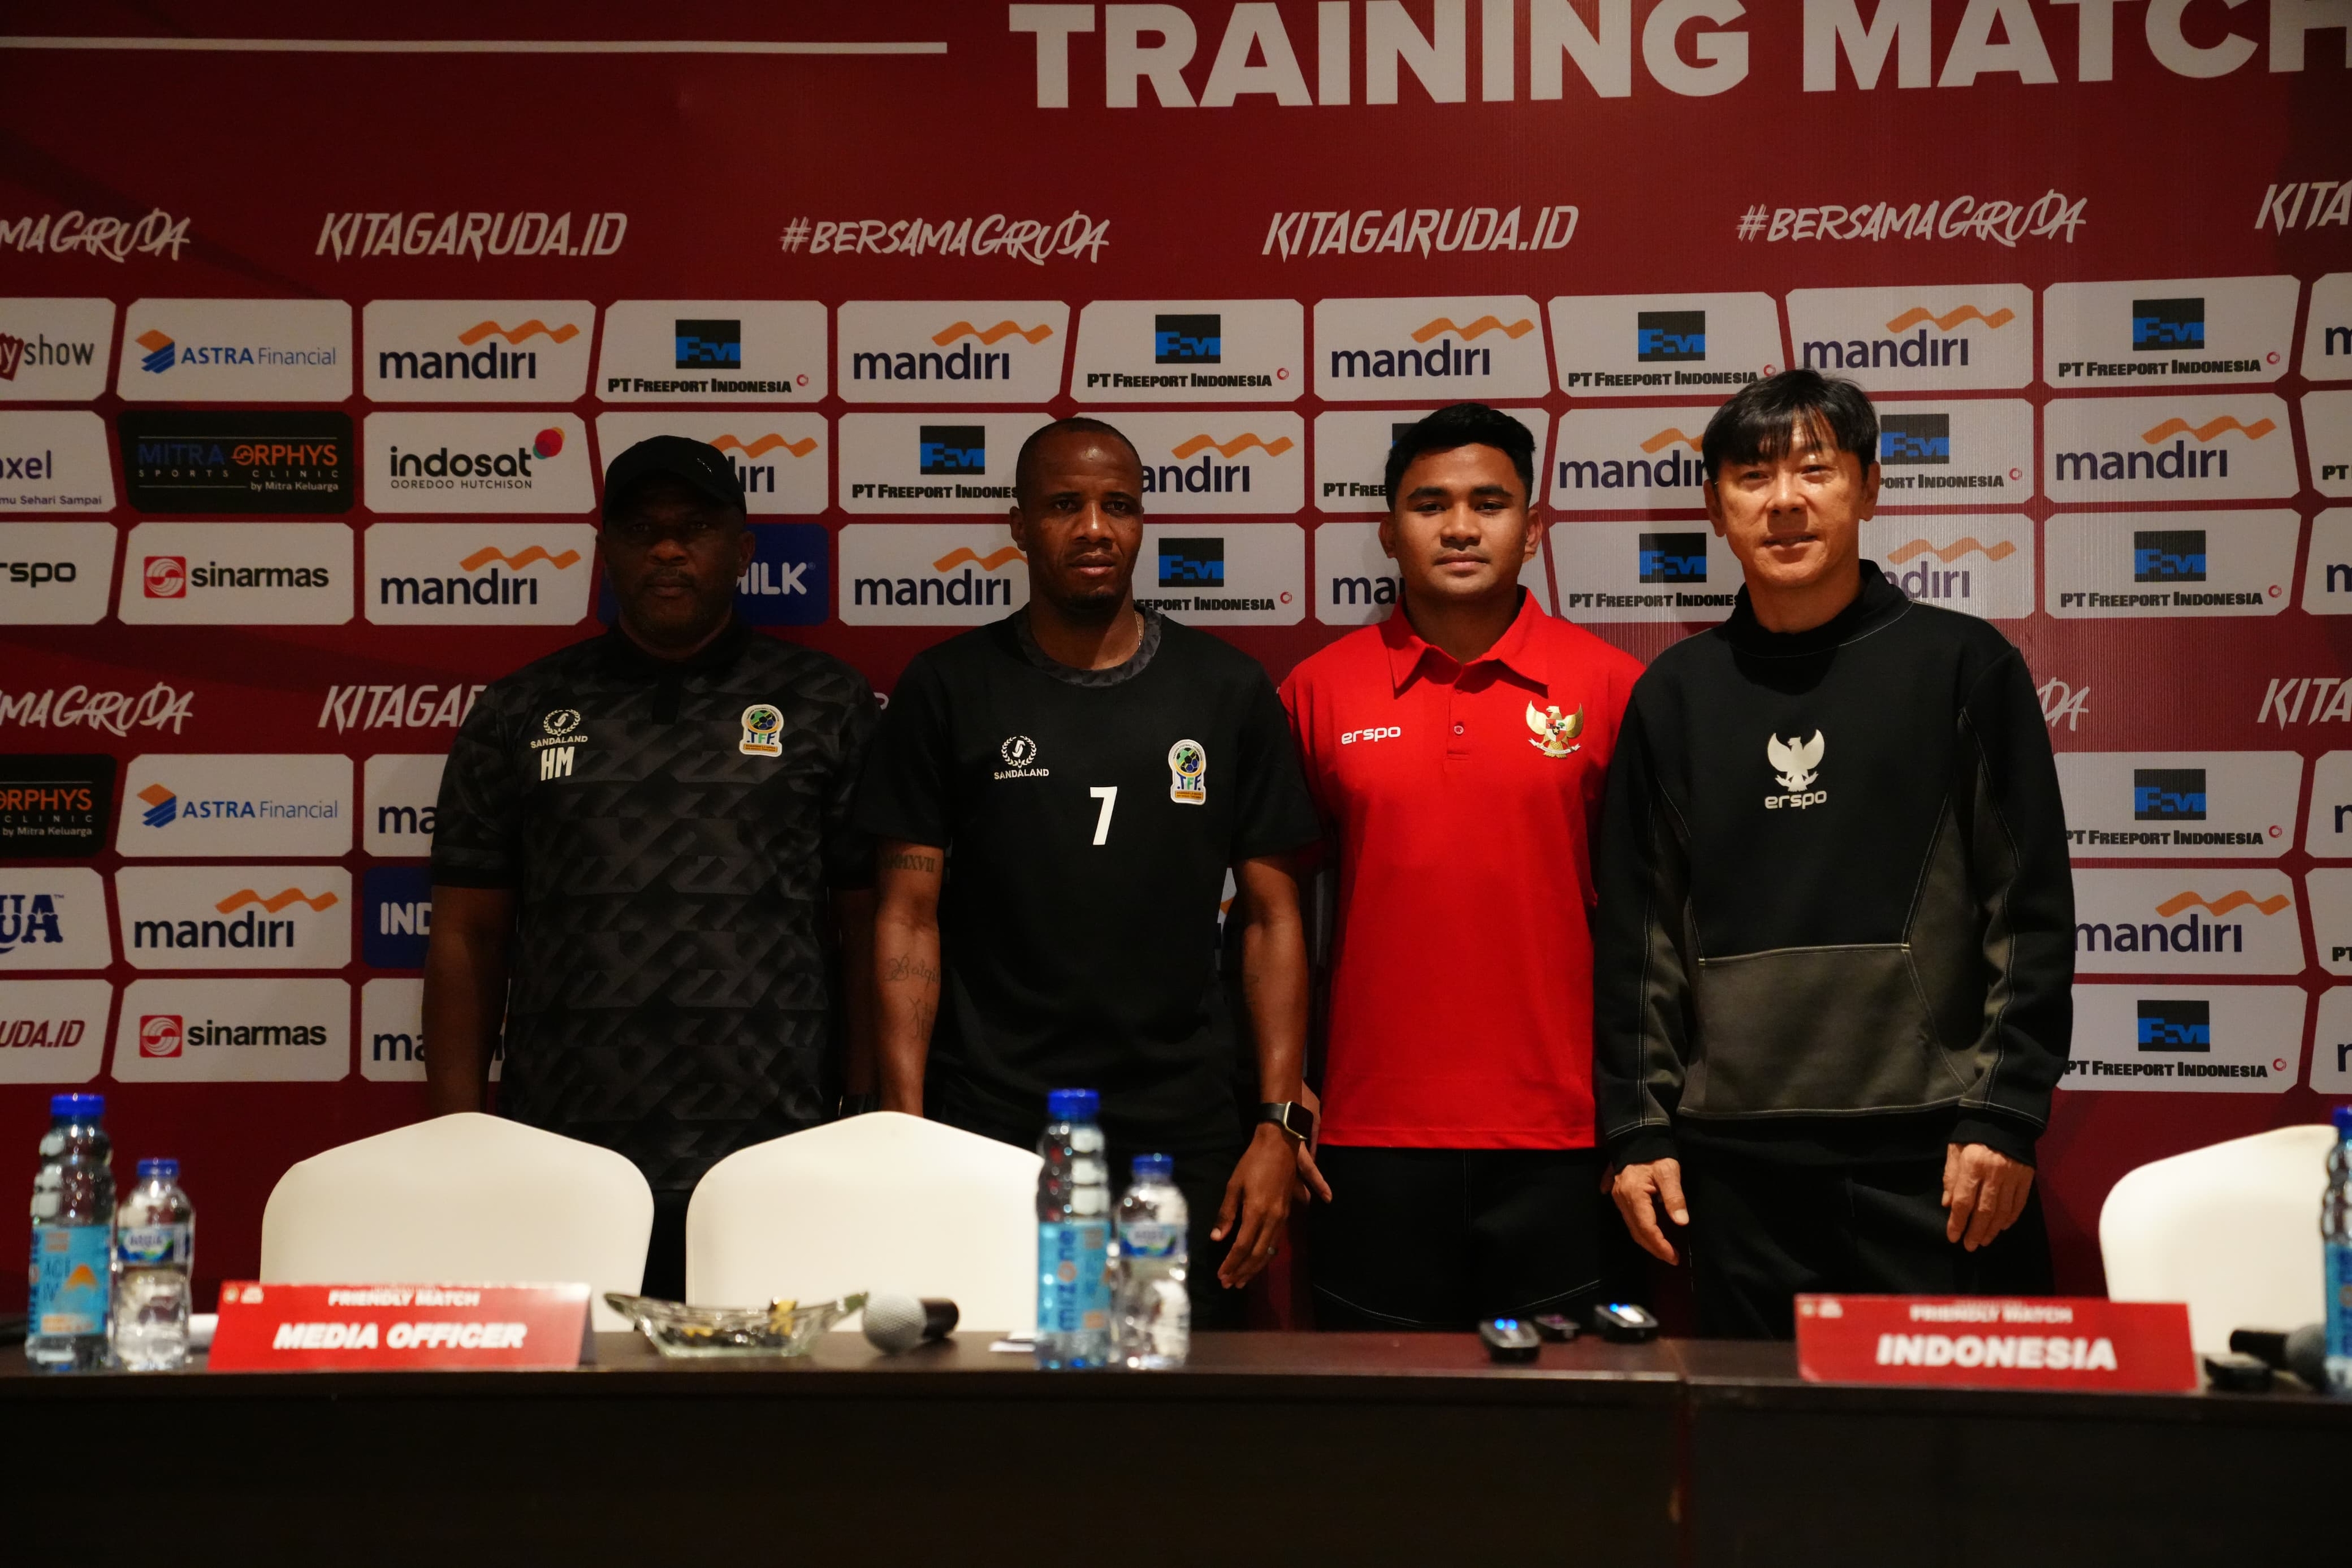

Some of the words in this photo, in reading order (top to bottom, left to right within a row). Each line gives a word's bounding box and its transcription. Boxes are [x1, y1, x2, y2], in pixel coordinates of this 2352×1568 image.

[1009, 0, 1749, 108] TRAINING
[1803, 0, 2352, 91] MATCH
[1736, 189, 2087, 247] #BERSAMAGARUDA
[2255, 178, 2352, 236] KITA
[0, 208, 190, 263] MAGARUDA
[315, 212, 628, 262] KITAGARUDA.ID
[778, 211, 1109, 266] #BERSAMAGARUDA
[1262, 205, 1579, 262] KITAGARUDA.ID
[0, 334, 94, 374] yshow
[181, 347, 254, 364] ASTRA
[258, 347, 336, 366] Financial
[380, 342, 535, 379] mandiri
[854, 343, 1009, 379] mandiri
[1332, 339, 1490, 378] mandiri
[1803, 330, 1968, 369] mandiri
[1088, 373, 1109, 387] PT
[1113, 373, 1188, 386] FREEPORT
[1191, 373, 1272, 387] INDONESIA
[1569, 372, 1593, 386] PT
[1595, 372, 1672, 386] FREEPORT
[1675, 371, 1758, 385] INDONESIA
[2059, 362, 2084, 377] PT
[2086, 361, 2168, 375] FREEPORT
[2171, 360, 2261, 374] INDONESIA
[608, 378, 630, 392] PT
[633, 379, 707, 393] FREEPORT
[710, 379, 791, 393] INDONESIA
[137, 443, 225, 466] MITRA
[231, 444, 338, 466] ORPHYS
[390, 446, 532, 477] indosat
[2056, 440, 2228, 480] mandiri
[391, 480, 454, 489] OOREDOO
[461, 480, 532, 489] HUTCHISON
[1142, 456, 1250, 492] andiri
[1918, 473, 2004, 489] INDONESIA
[2323, 465, 2349, 480] PT
[251, 481, 262, 492] by
[265, 481, 292, 491] Mitra
[295, 481, 339, 493] Keluarga
[853, 484, 875, 498] PT
[878, 484, 953, 499] FREEPORT
[956, 484, 1019, 498] INDONES
[1324, 483, 1347, 497] PT
[1350, 483, 1387, 497] FREE
[20, 496, 56, 505] Sehari
[59, 496, 102, 506] Sampai
[191, 562, 328, 587] sinarmas
[381, 568, 537, 605] mandiri
[854, 569, 1011, 605] mandiri
[1194, 597, 1275, 611] INDONESIA
[1570, 594, 1594, 608] PT
[1596, 593, 1673, 607] FREEPORT
[2061, 593, 2086, 608] PT
[2089, 592, 2171, 607] FREEPORT
[2174, 591, 2263, 606] INDONESIA
[0, 682, 194, 737] MAGARUDA
[317, 684, 488, 736] KITAGA
[2256, 677, 2352, 731] KITA
[530, 735, 588, 748] SANDALAND
[1341, 726, 1401, 745] erspo
[540, 746, 575, 781] HM
[993, 768, 1049, 780] SANDALAND
[183, 802, 255, 818] ASTRA
[260, 801, 338, 819] Financial
[1765, 790, 1826, 809] erspo
[1090, 786, 1117, 845] 7
[2, 827, 14, 837] by
[17, 827, 45, 835] Mitra
[48, 827, 92, 837] Keluarga
[2089, 831, 2170, 845] FREEPORT
[2174, 831, 2263, 845] INDONESIA
[134, 911, 293, 948] mandiri
[2075, 914, 2242, 952] mandiri
[187, 1019, 326, 1046] sinarmas
[2065, 1061, 2089, 1076] PT
[2092, 1062, 2174, 1077] FREEPORT
[2177, 1063, 2267, 1078] INDONESIA
[273, 1322, 379, 1349] MEDIA
[386, 1322, 528, 1349] OFFICER
[1875, 1333, 2118, 1370] INDONESIA
